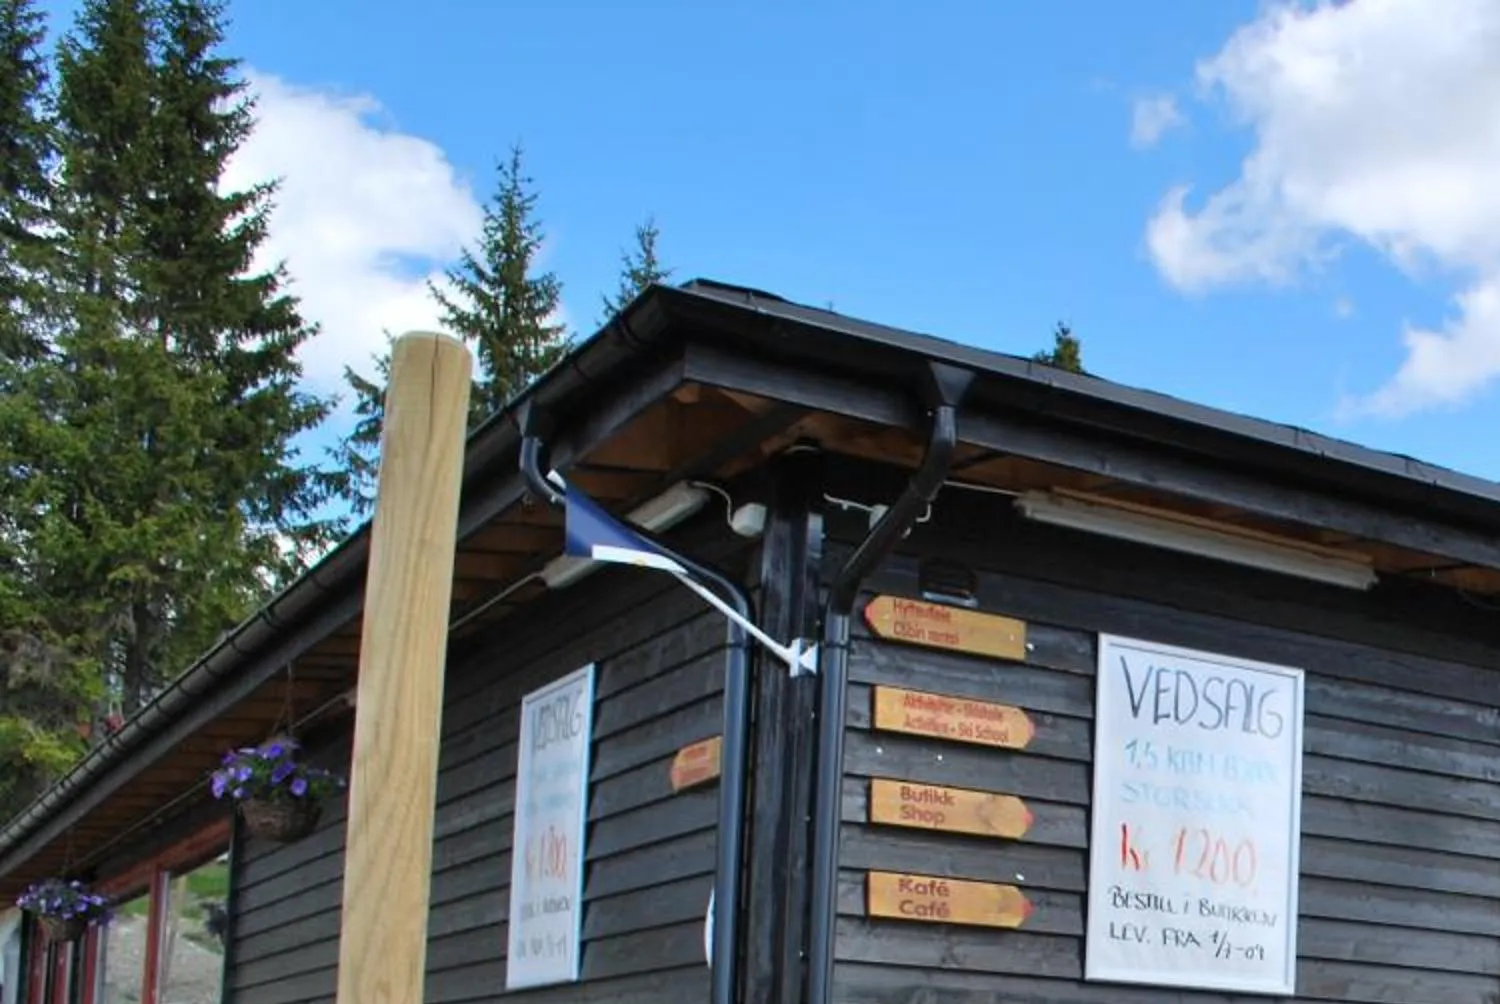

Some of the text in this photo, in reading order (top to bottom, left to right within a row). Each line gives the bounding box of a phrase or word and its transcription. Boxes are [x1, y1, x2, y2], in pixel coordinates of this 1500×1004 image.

[1120, 655, 1284, 740] VEDSALG
[900, 785, 955, 806] Butikk
[899, 804, 946, 828] Shop
[898, 899, 951, 918] Café
